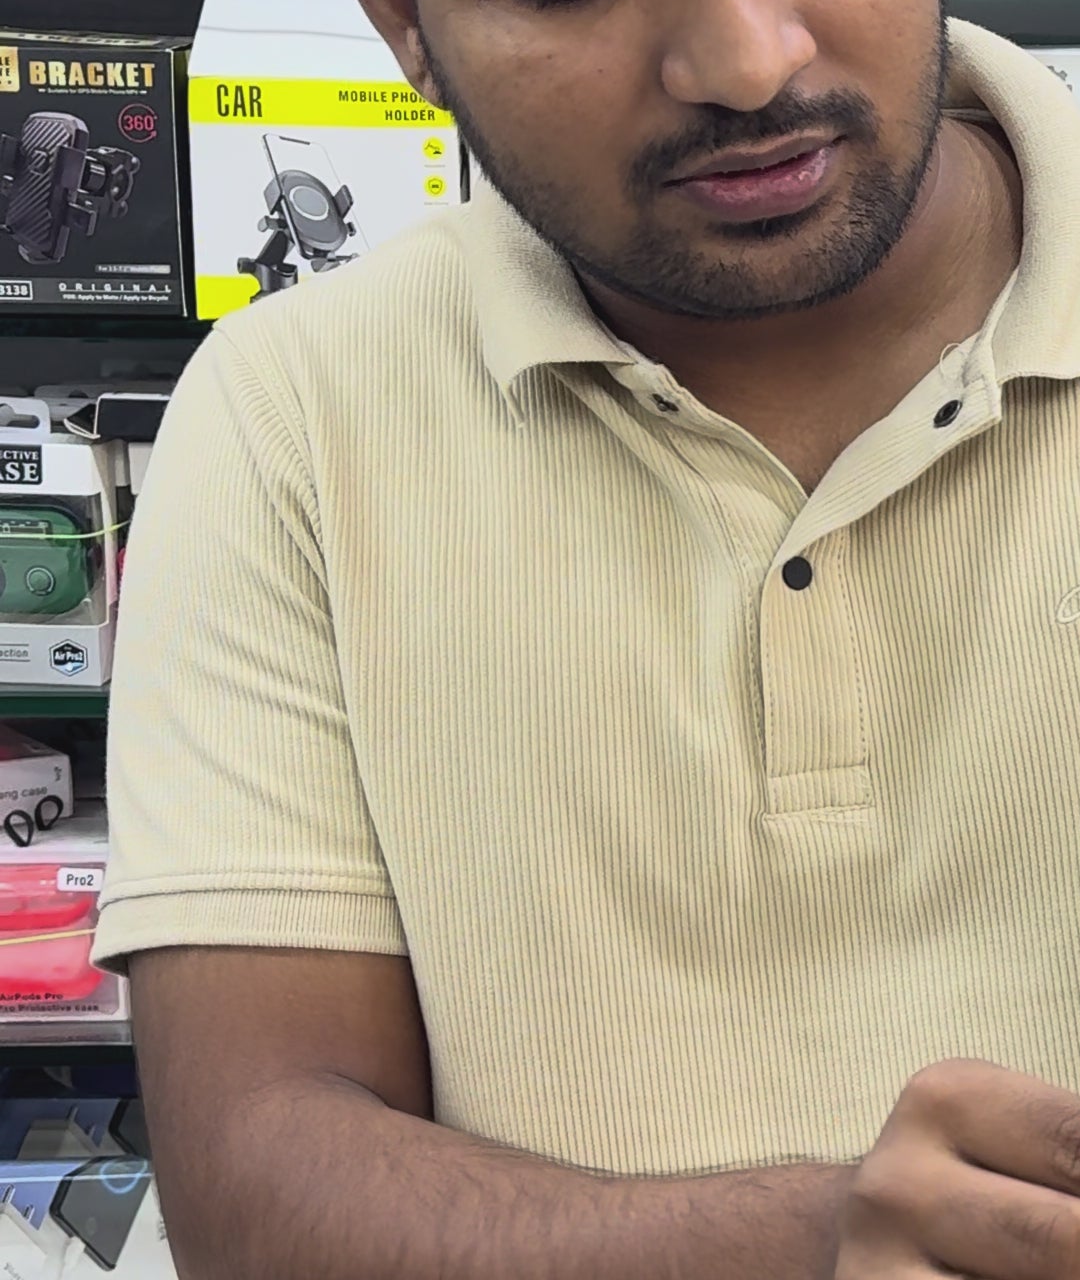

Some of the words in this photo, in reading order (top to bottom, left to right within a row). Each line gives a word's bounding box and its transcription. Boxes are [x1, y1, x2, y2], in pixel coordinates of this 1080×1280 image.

[29, 61, 155, 87] BRACKET
[217, 84, 263, 118] CAR
[339, 91, 387, 103] MOBILE
[392, 92, 427, 103] PHO
[385, 110, 435, 121] HOLDER
[59, 282, 171, 293] ORIGINAL
[22, 785, 47, 798] case
[66, 873, 94, 886] Pro2
[45, 993, 63, 1001] Pro
